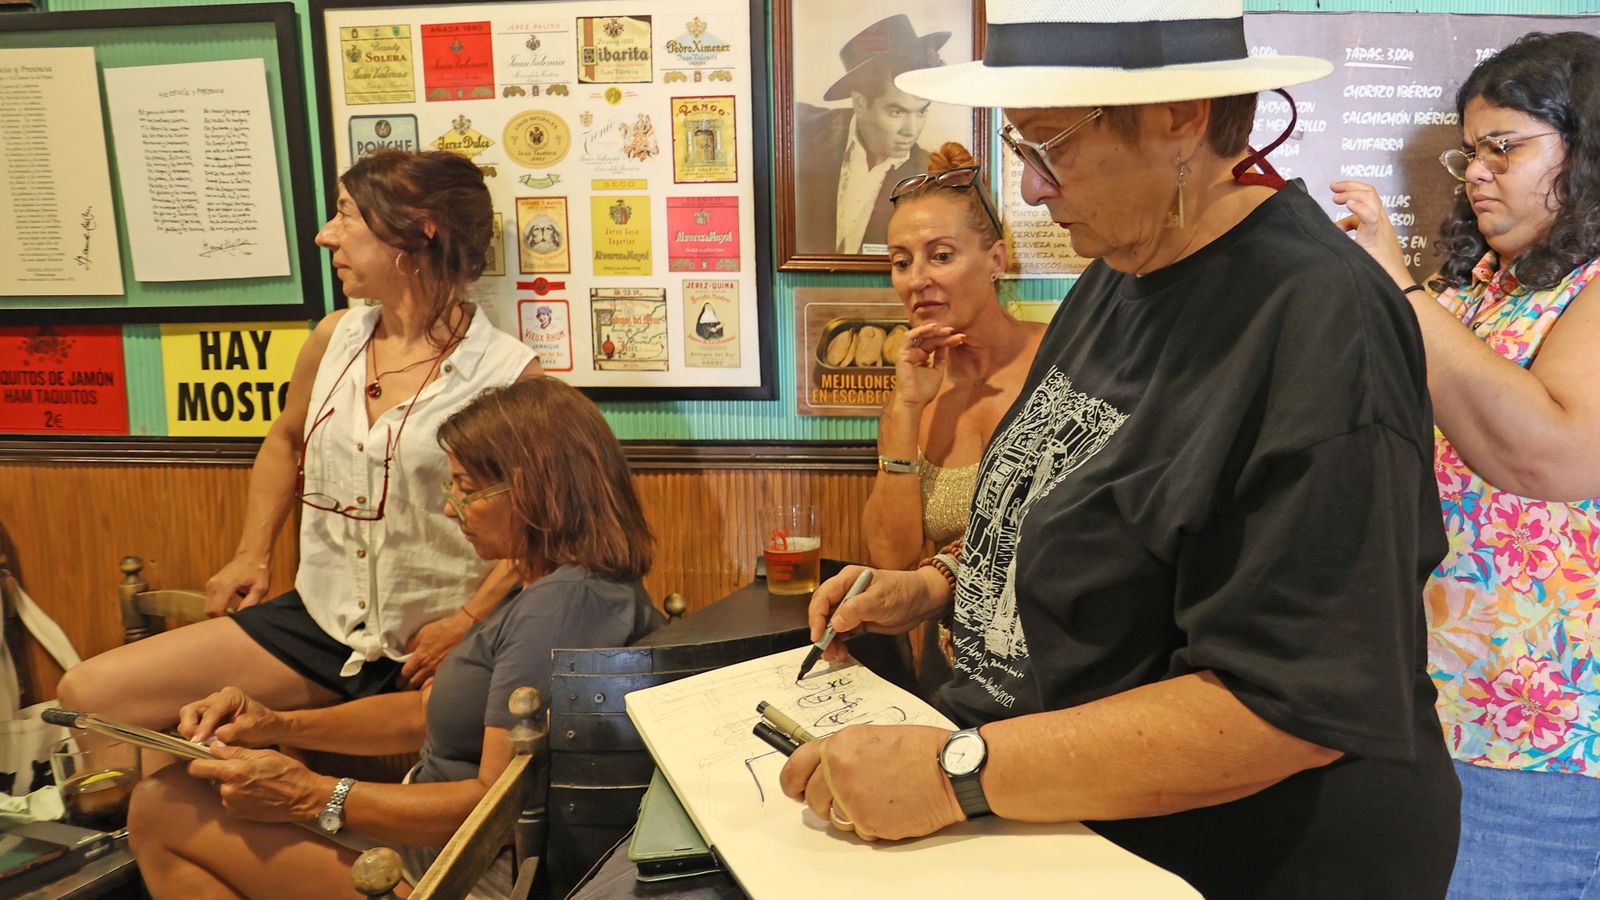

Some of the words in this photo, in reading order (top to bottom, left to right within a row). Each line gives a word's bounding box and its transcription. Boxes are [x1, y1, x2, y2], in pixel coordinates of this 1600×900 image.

[1343, 85, 1394, 99] CHORIZO
[1396, 81, 1443, 99] IBÉRICO
[1342, 109, 1412, 126] SALCHICHÓN
[1413, 107, 1459, 126] IBÉRICO
[1341, 137, 1404, 152] BUTIFARRA
[1340, 164, 1394, 178] MORCILLA
[1011, 220, 1055, 228] CERVEZA
[1011, 231, 1055, 239] CERVEZA
[1410, 236, 1428, 249] EN
[1011, 241, 1052, 249] CERVEZA
[1011, 251, 1055, 259] CERVEZA
[200, 330, 272, 371] HAY
[49, 371, 65, 386] DE
[68, 369, 114, 386] JAMÓN
[822, 374, 897, 389] MEJILLONES
[4, 389, 33, 405] HAM
[36, 389, 98, 405] TAQUITOS
[812, 389, 827, 403] EN
[45, 411, 64, 428] 2€
